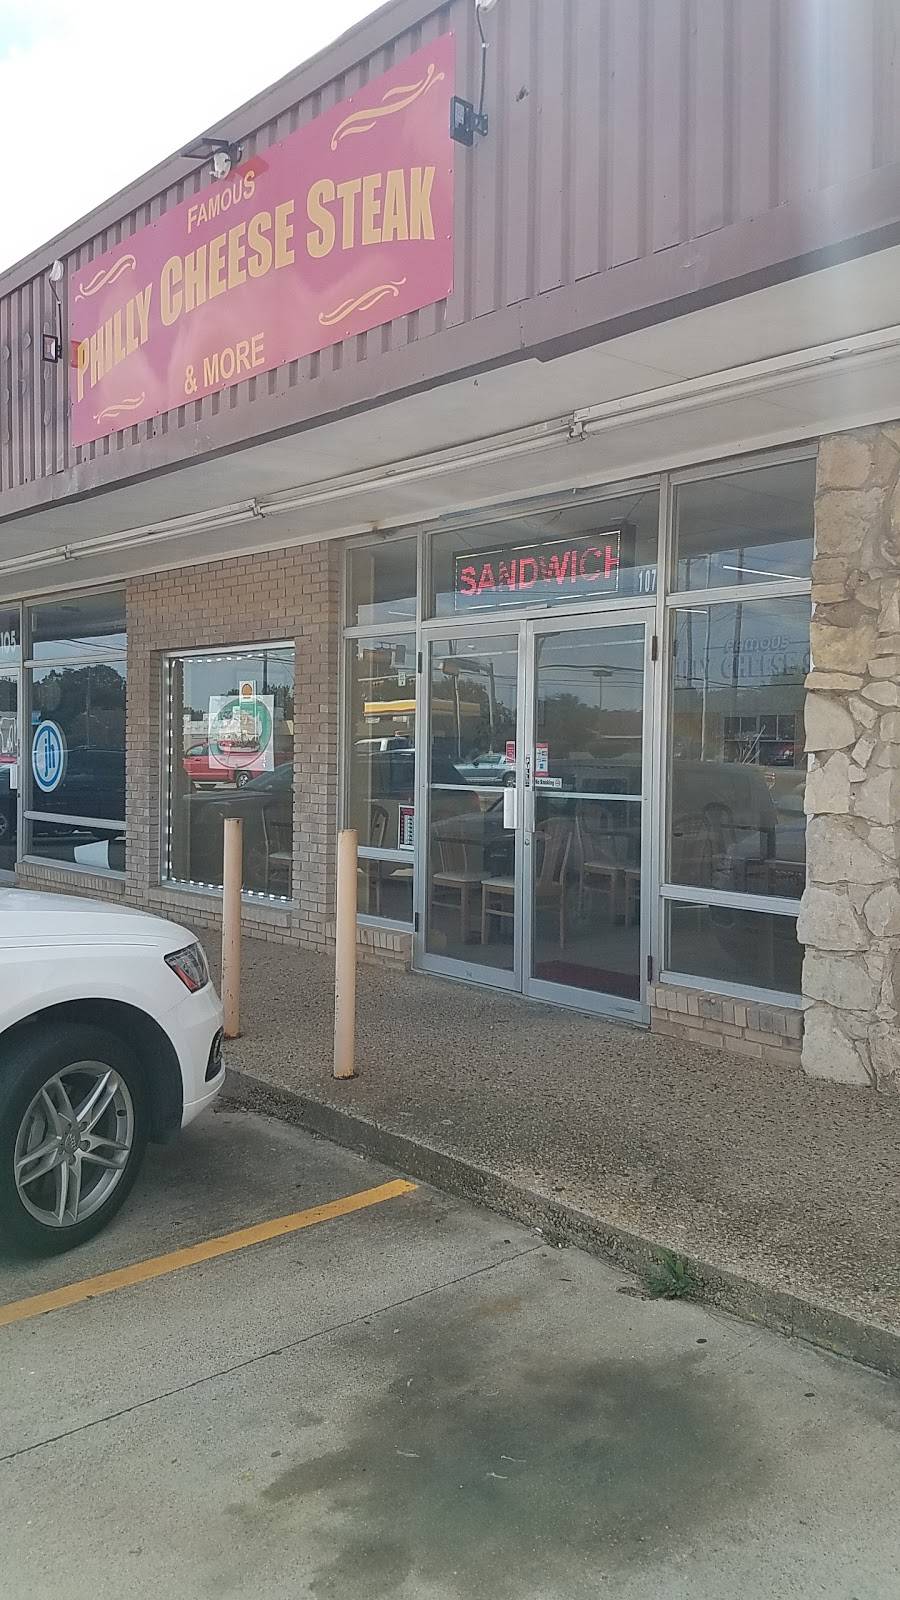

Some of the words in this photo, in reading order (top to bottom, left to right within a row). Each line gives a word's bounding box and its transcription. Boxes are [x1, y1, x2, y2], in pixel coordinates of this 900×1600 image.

[187, 169, 256, 234] FAMOUS
[77, 282, 153, 403] PHILLY
[159, 199, 295, 327] CHEESE
[306, 166, 436, 258] STEAK
[184, 364, 198, 395] &
[203, 332, 265, 388] MORE
[460, 545, 620, 596] SANDWICH
[638, 568, 657, 593] 107
